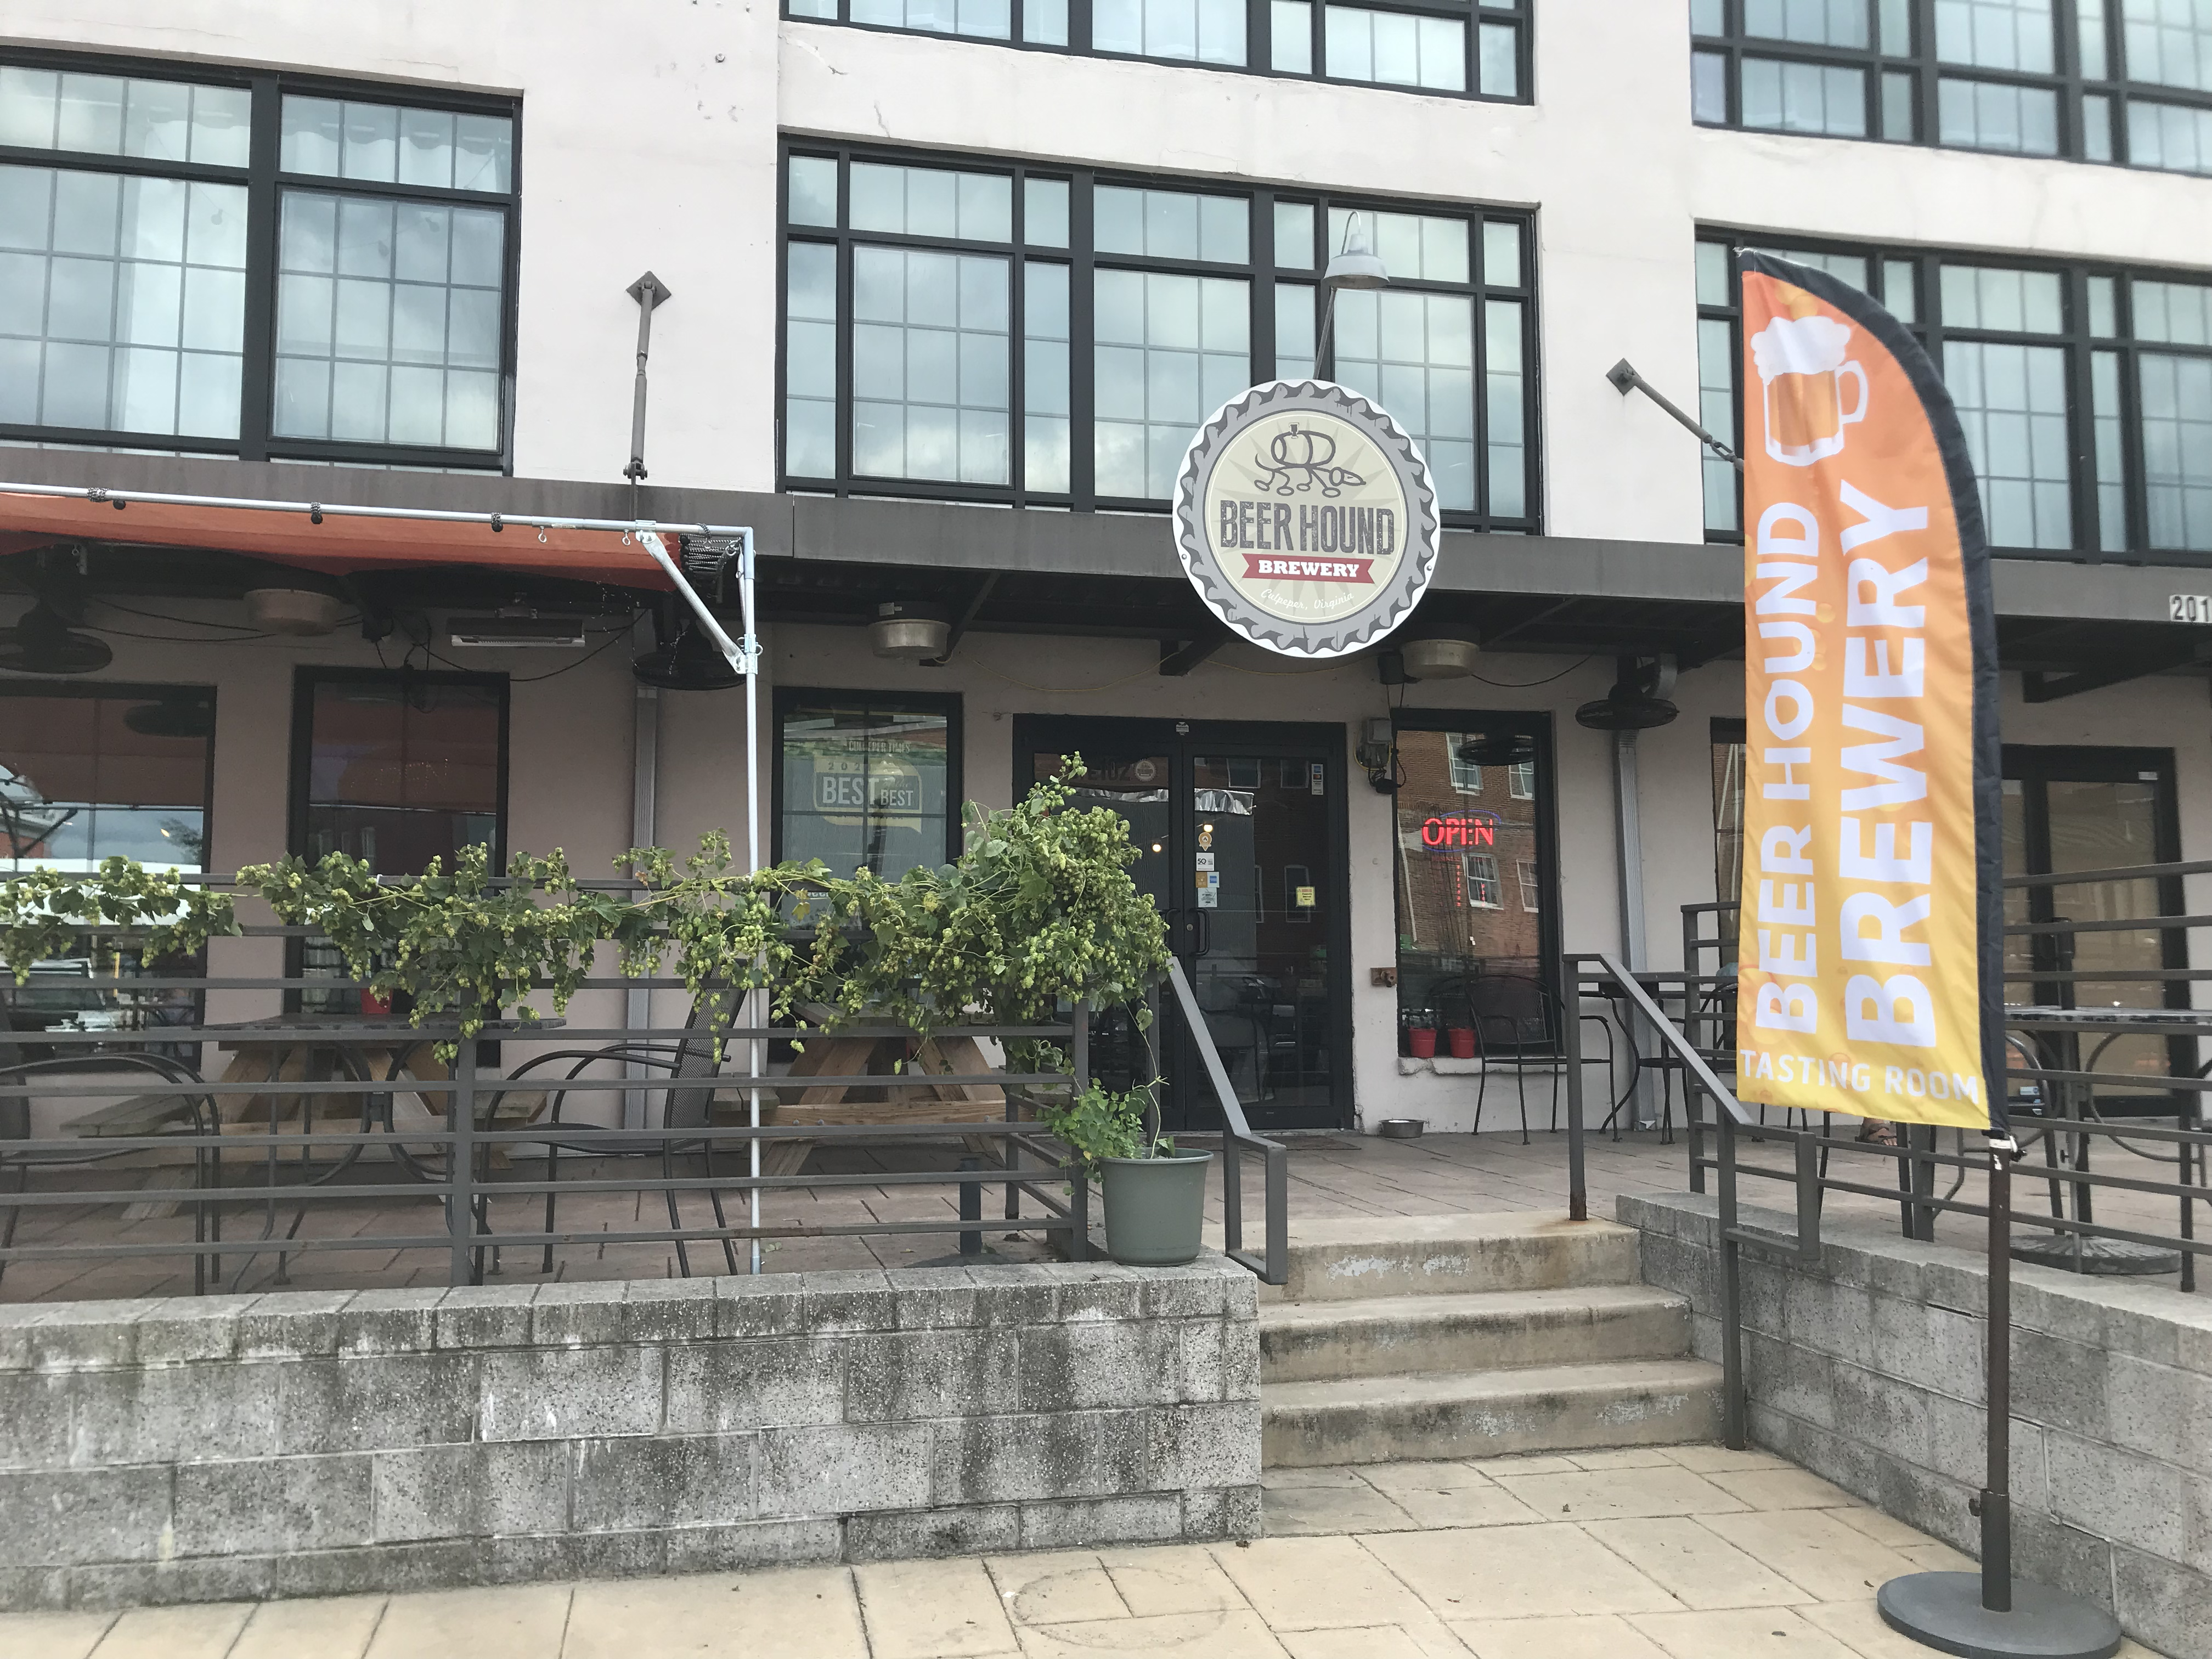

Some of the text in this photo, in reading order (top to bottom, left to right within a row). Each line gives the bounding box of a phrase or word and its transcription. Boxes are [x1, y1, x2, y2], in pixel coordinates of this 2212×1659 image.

[1220, 500, 1395, 555] BEER HOUND
[1258, 560, 1359, 577] BREWERY
[1261, 588, 1354, 611] Culpeper, Virginia
[2173, 596, 2209, 622] 201
[849, 741, 886, 752] CULEPER
[1756, 502, 1819, 1034] BEER HOUND
[1839, 479, 1936, 1047] BREWERY
[822, 776, 879, 805] BEST
[881, 789, 913, 806] BEST
[1422, 818, 1494, 845] OPEN
[1740, 1049, 1979, 1105] TASTING ROOM
